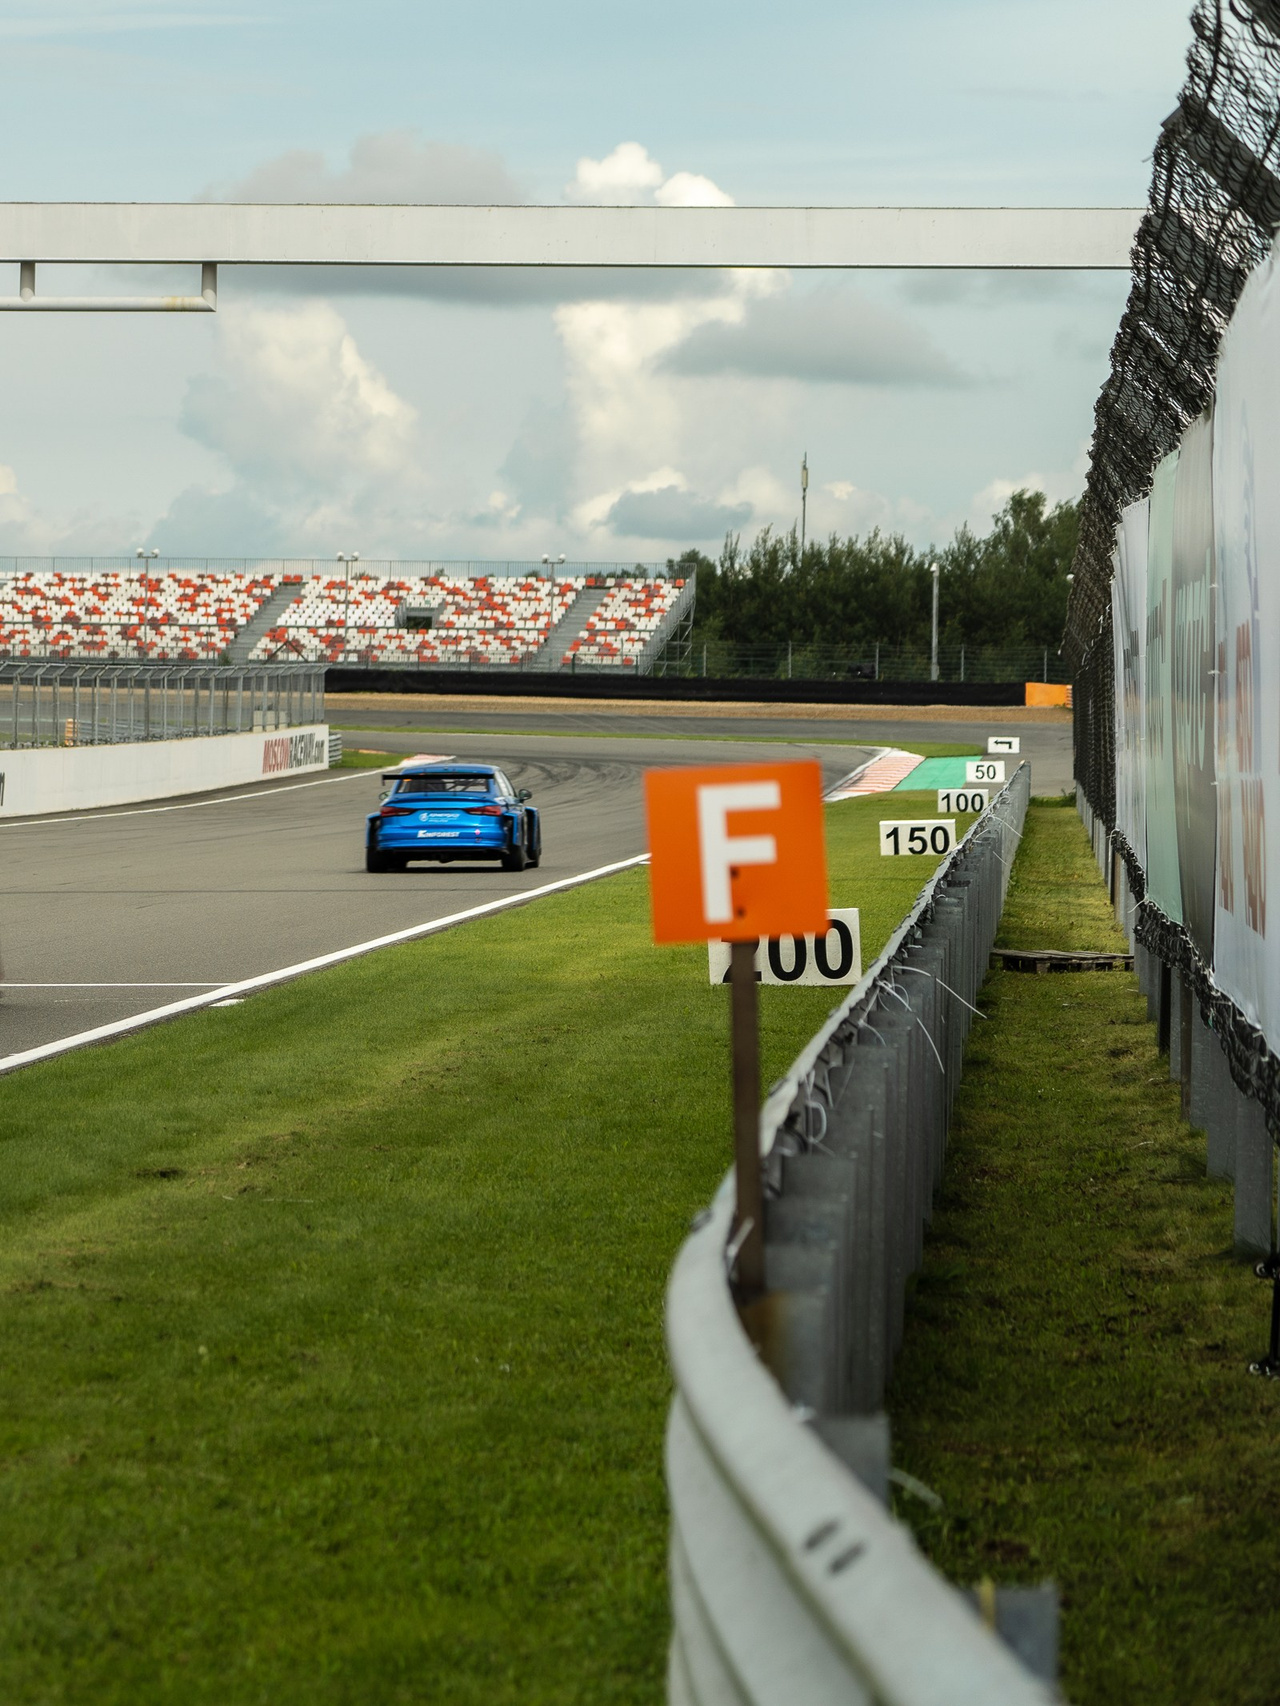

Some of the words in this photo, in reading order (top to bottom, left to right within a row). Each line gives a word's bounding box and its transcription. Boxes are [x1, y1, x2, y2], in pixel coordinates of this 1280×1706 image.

[975, 764, 997, 780] 50
[941, 792, 985, 813] 100
[696, 779, 782, 924] F
[885, 825, 950, 856] 150
